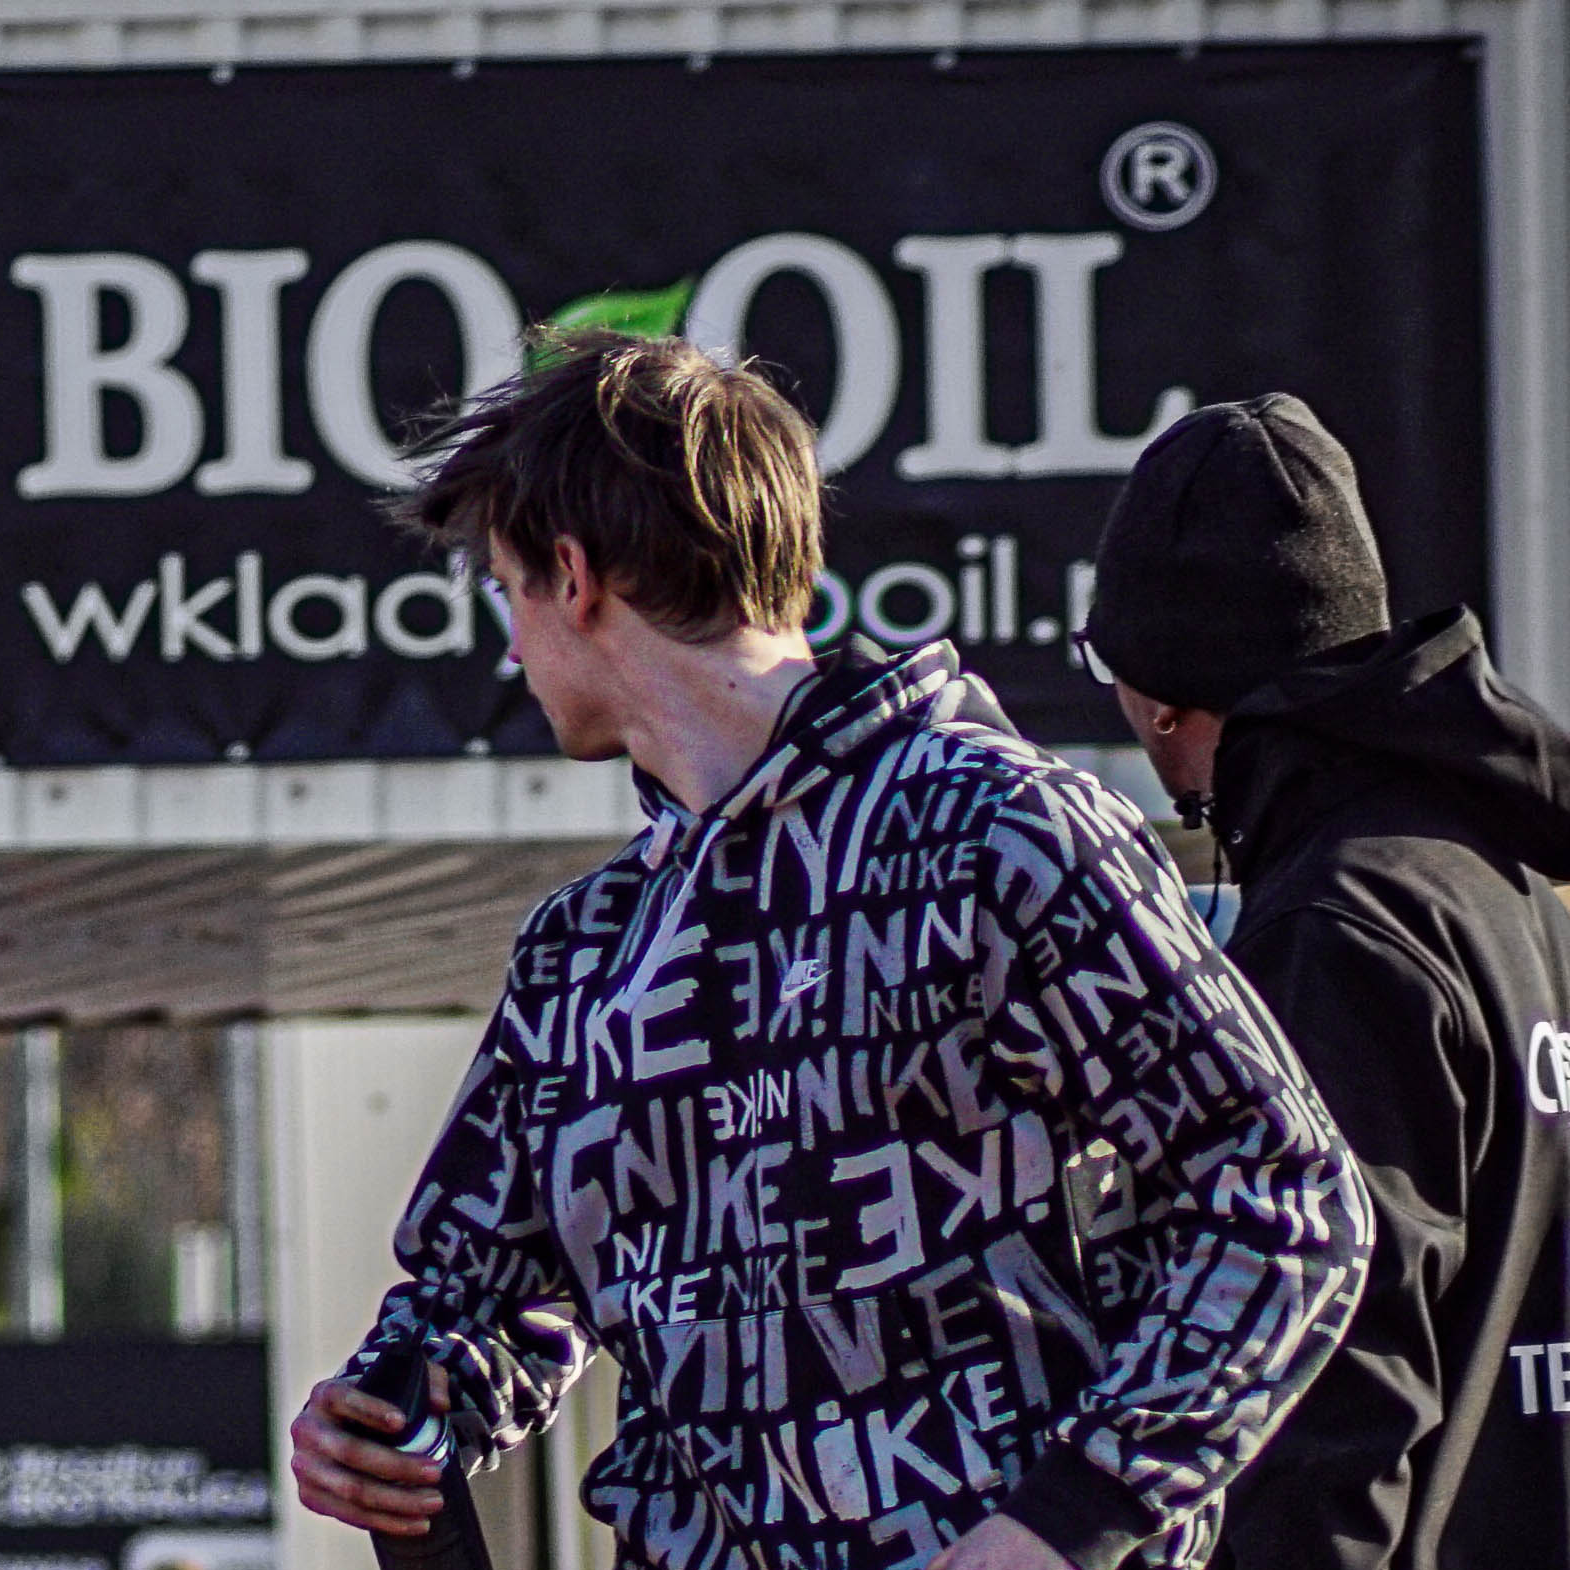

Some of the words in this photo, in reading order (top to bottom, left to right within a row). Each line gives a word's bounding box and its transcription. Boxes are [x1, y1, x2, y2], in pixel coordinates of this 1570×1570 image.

[861, 841, 985, 896] NIKE
[503, 922, 711, 1101] NIKE
[796, 1017, 1009, 1152] NIKE
